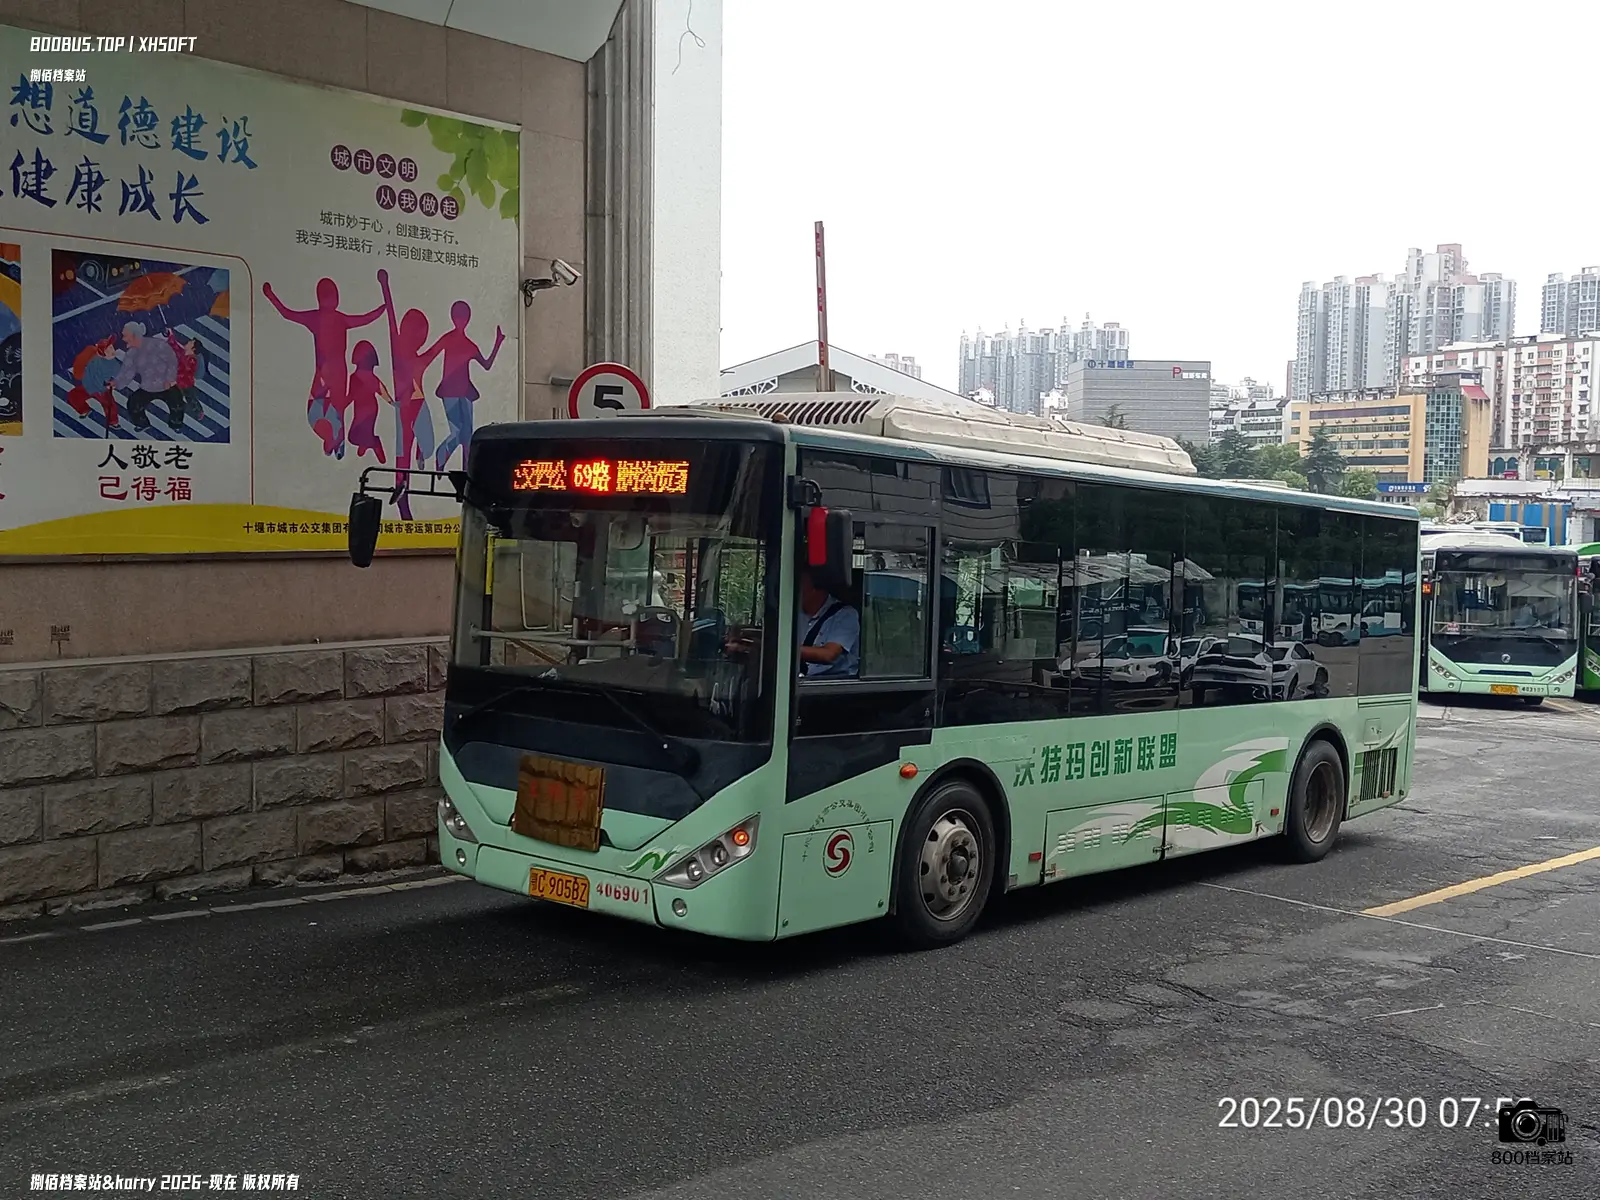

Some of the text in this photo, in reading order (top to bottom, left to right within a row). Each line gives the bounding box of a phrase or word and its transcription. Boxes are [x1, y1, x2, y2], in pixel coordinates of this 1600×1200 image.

[9, 73, 258, 170] 想道德建设
[332, 146, 416, 181] 城市文明
[0, 147, 210, 225] 健康成长
[377, 187, 459, 219] 从我做起
[1173, 367, 1182, 378] P
[593, 385, 625, 418] 5
[97, 443, 193, 470] 人敬老
[98, 475, 193, 501] 己得福
[573, 462, 611, 492] 69路
[596, 883, 649, 905] 406901
